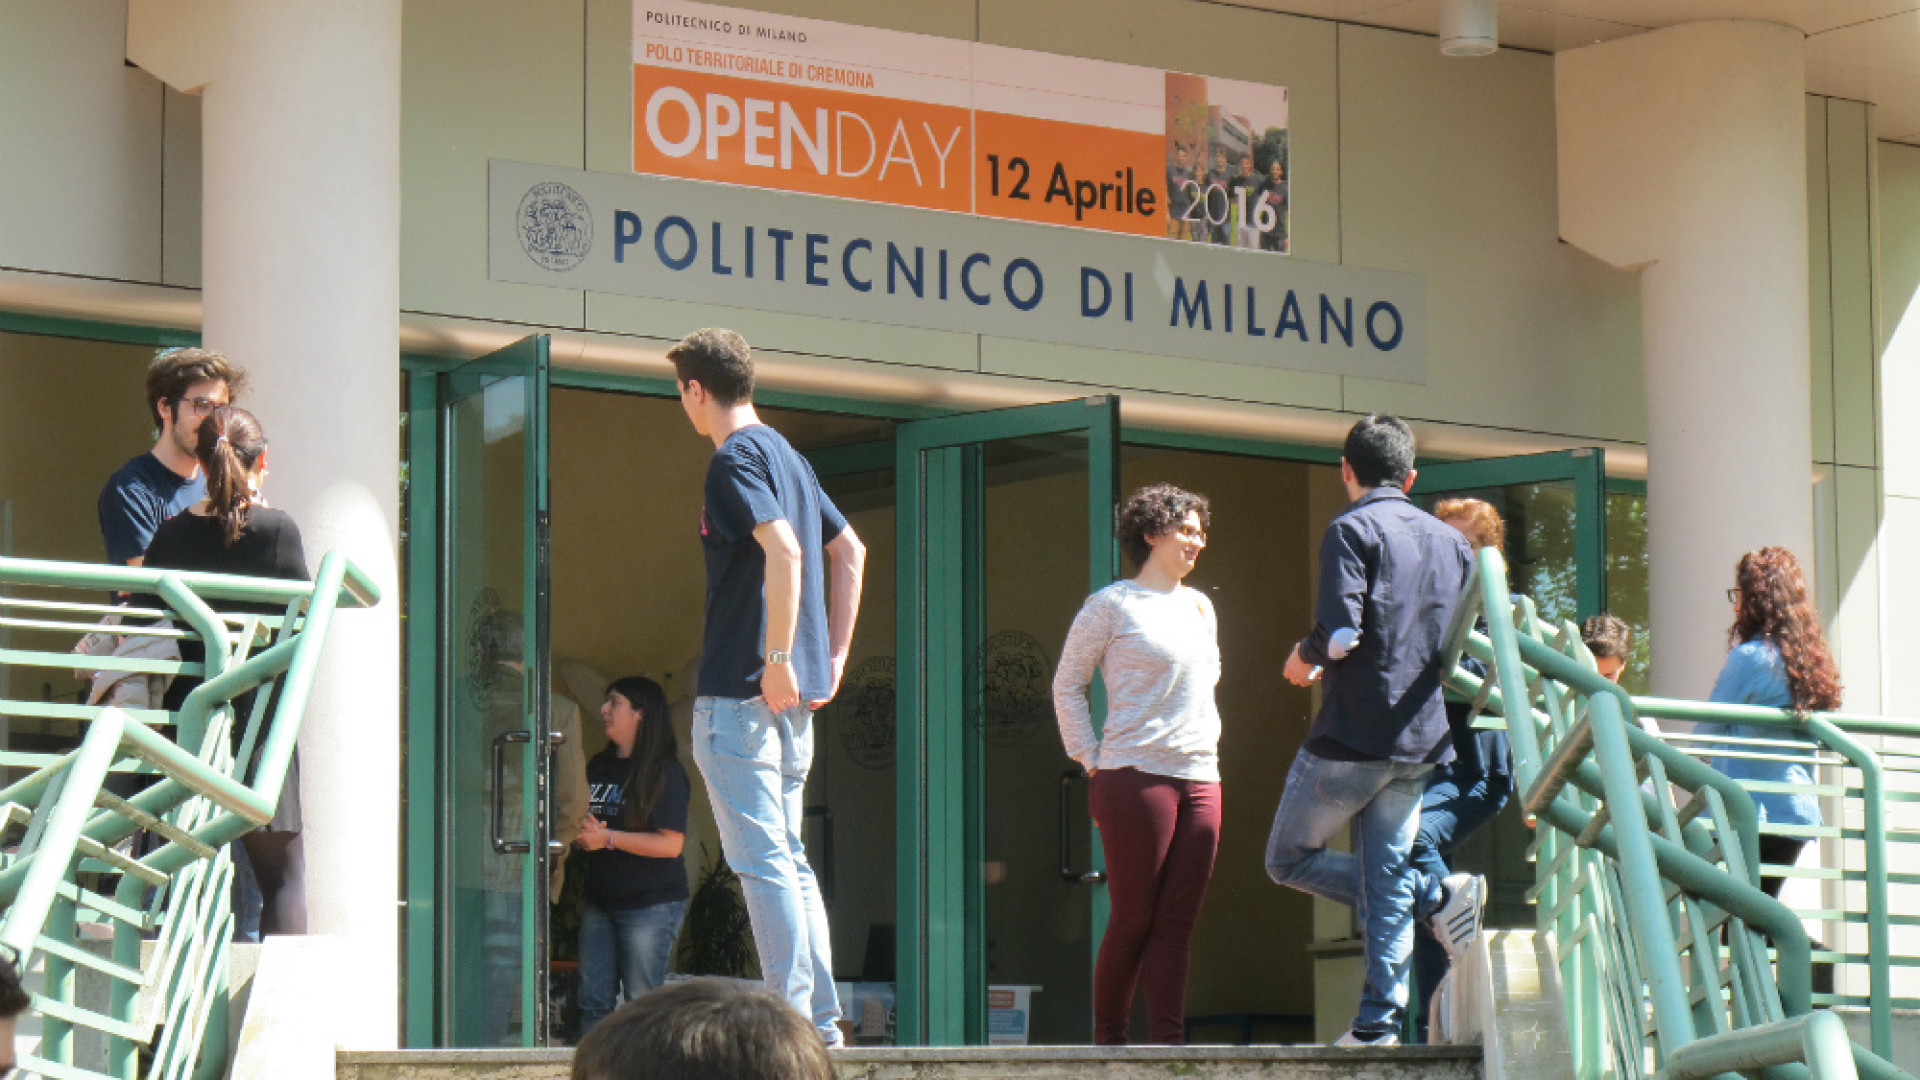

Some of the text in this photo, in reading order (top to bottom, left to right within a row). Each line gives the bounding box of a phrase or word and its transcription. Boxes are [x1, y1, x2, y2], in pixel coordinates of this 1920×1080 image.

[646, 11, 807, 43] POLITECNICO DI MILANO
[646, 42, 875, 89] POLO TERRITORIALE DI CREMONA
[644, 85, 962, 189] OPENDAY
[987, 154, 1277, 233] 12 Aprile 2016
[614, 209, 1404, 352] POLITECNICO DI MILANO
